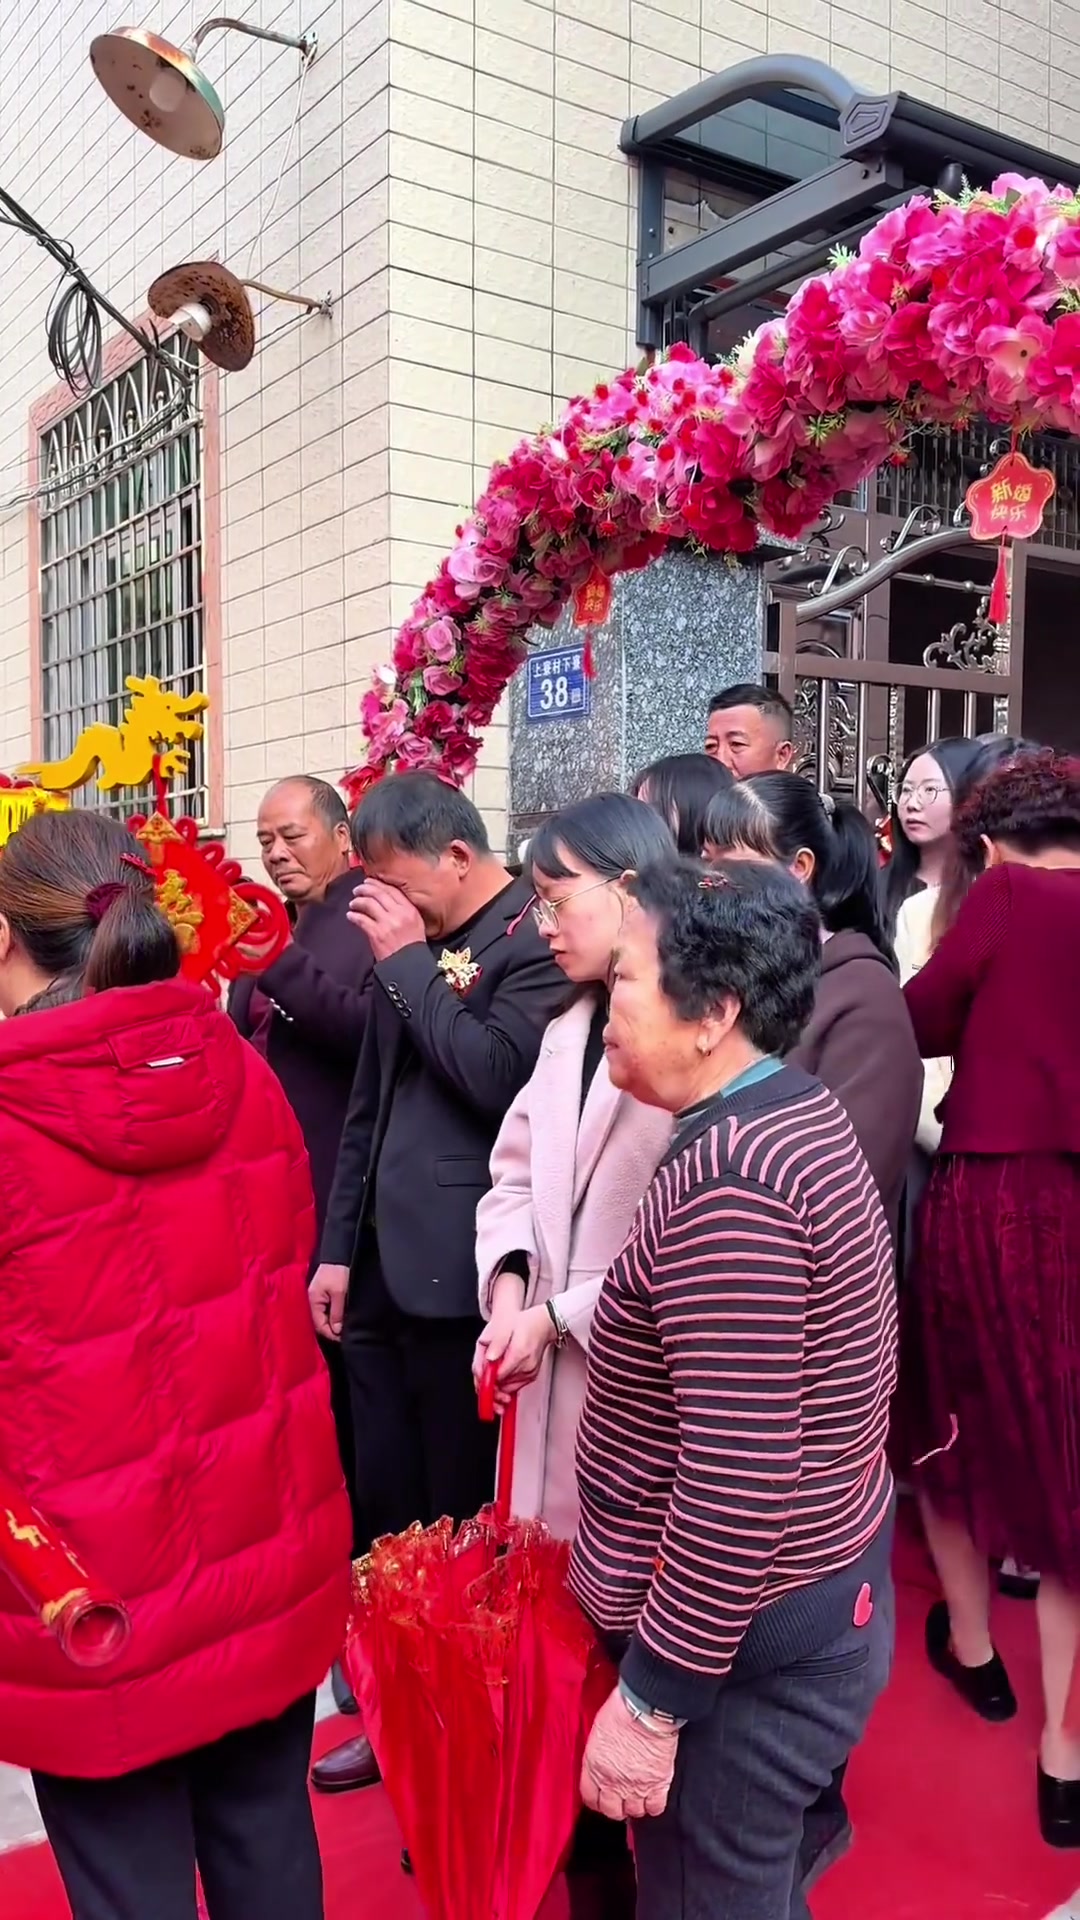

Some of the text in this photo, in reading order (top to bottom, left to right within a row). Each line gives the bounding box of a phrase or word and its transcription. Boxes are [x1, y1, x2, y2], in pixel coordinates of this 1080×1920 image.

[991, 477, 1033, 503] 新婚
[991, 503, 1026, 522] 快乐
[540, 676, 568, 710] 38
